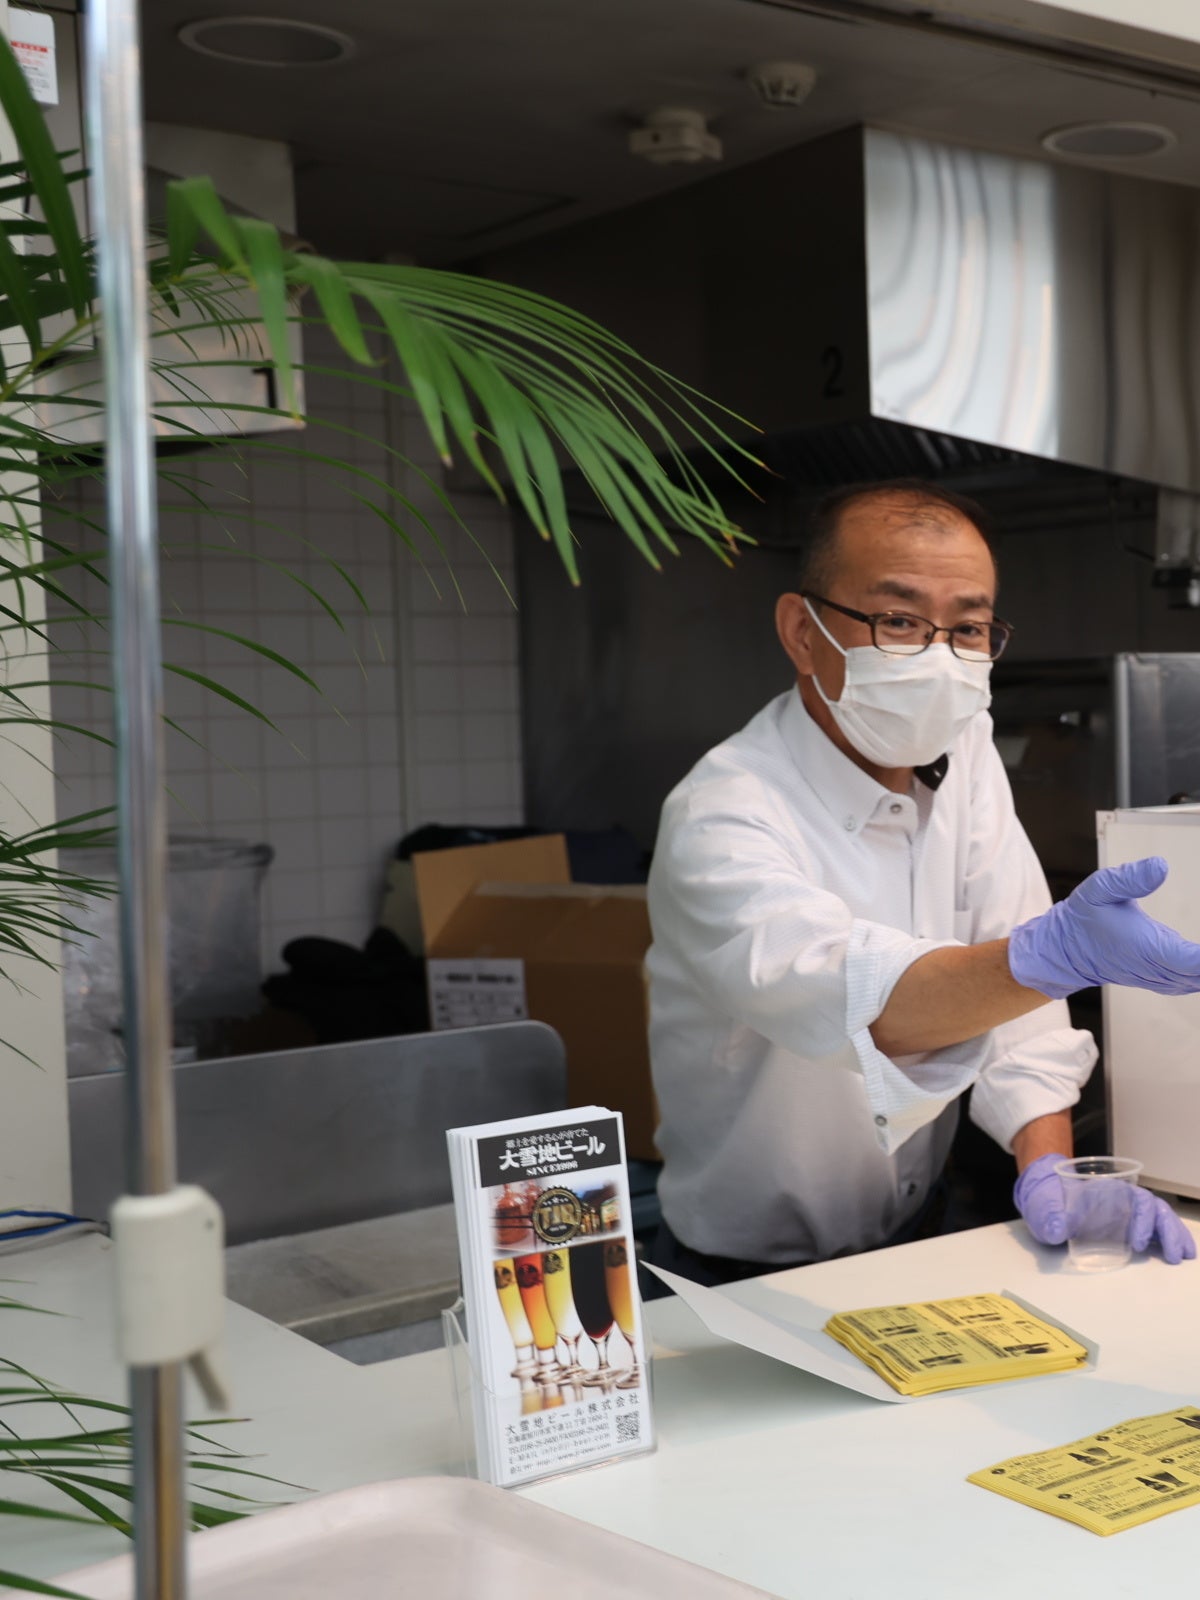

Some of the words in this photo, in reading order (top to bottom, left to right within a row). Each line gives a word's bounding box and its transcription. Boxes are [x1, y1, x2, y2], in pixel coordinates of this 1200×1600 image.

[820, 345, 845, 400] 2
[498, 1135, 606, 1171] 大雪地ビール
